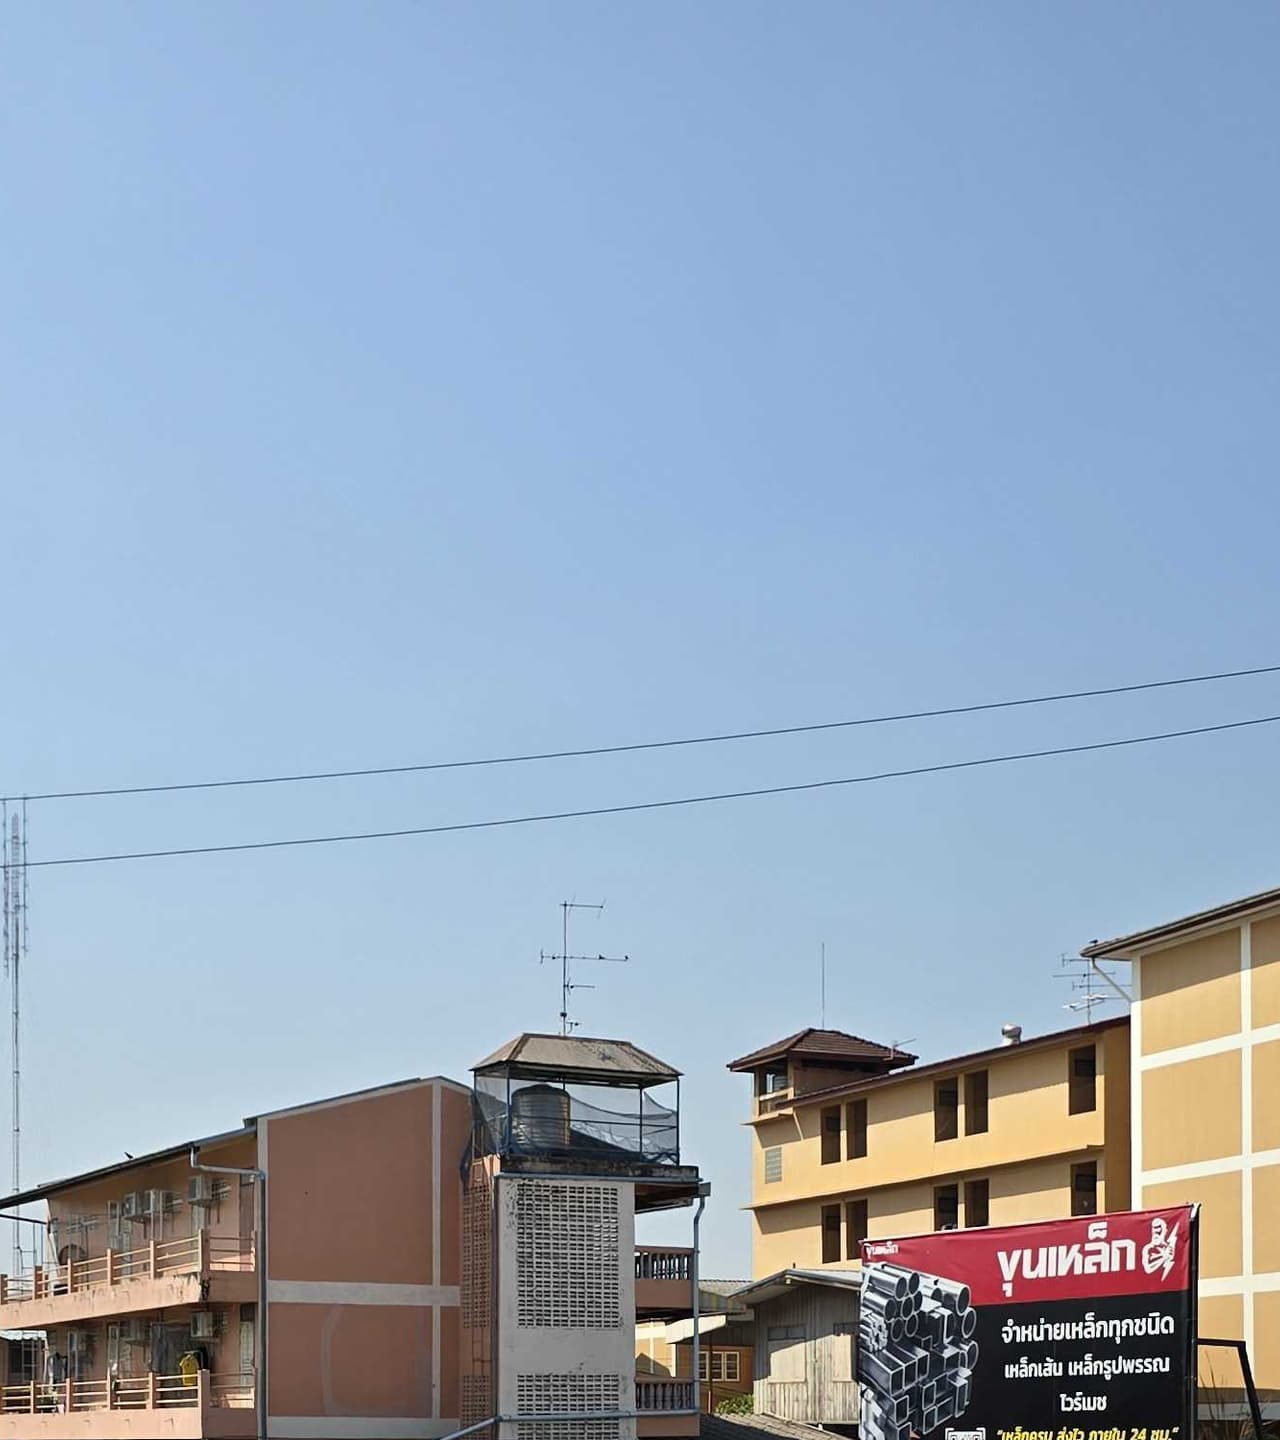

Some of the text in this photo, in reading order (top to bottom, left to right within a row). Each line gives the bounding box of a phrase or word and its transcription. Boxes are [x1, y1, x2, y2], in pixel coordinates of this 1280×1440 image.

[997, 1221, 1136, 1297] ขุนเหล็ก
[1001, 1312, 1175, 1345] จำหน่ายเหล็กทุกชนิด
[1004, 1353, 1171, 1381] เหล็กเส้น เหล็กรูปพรรณ
